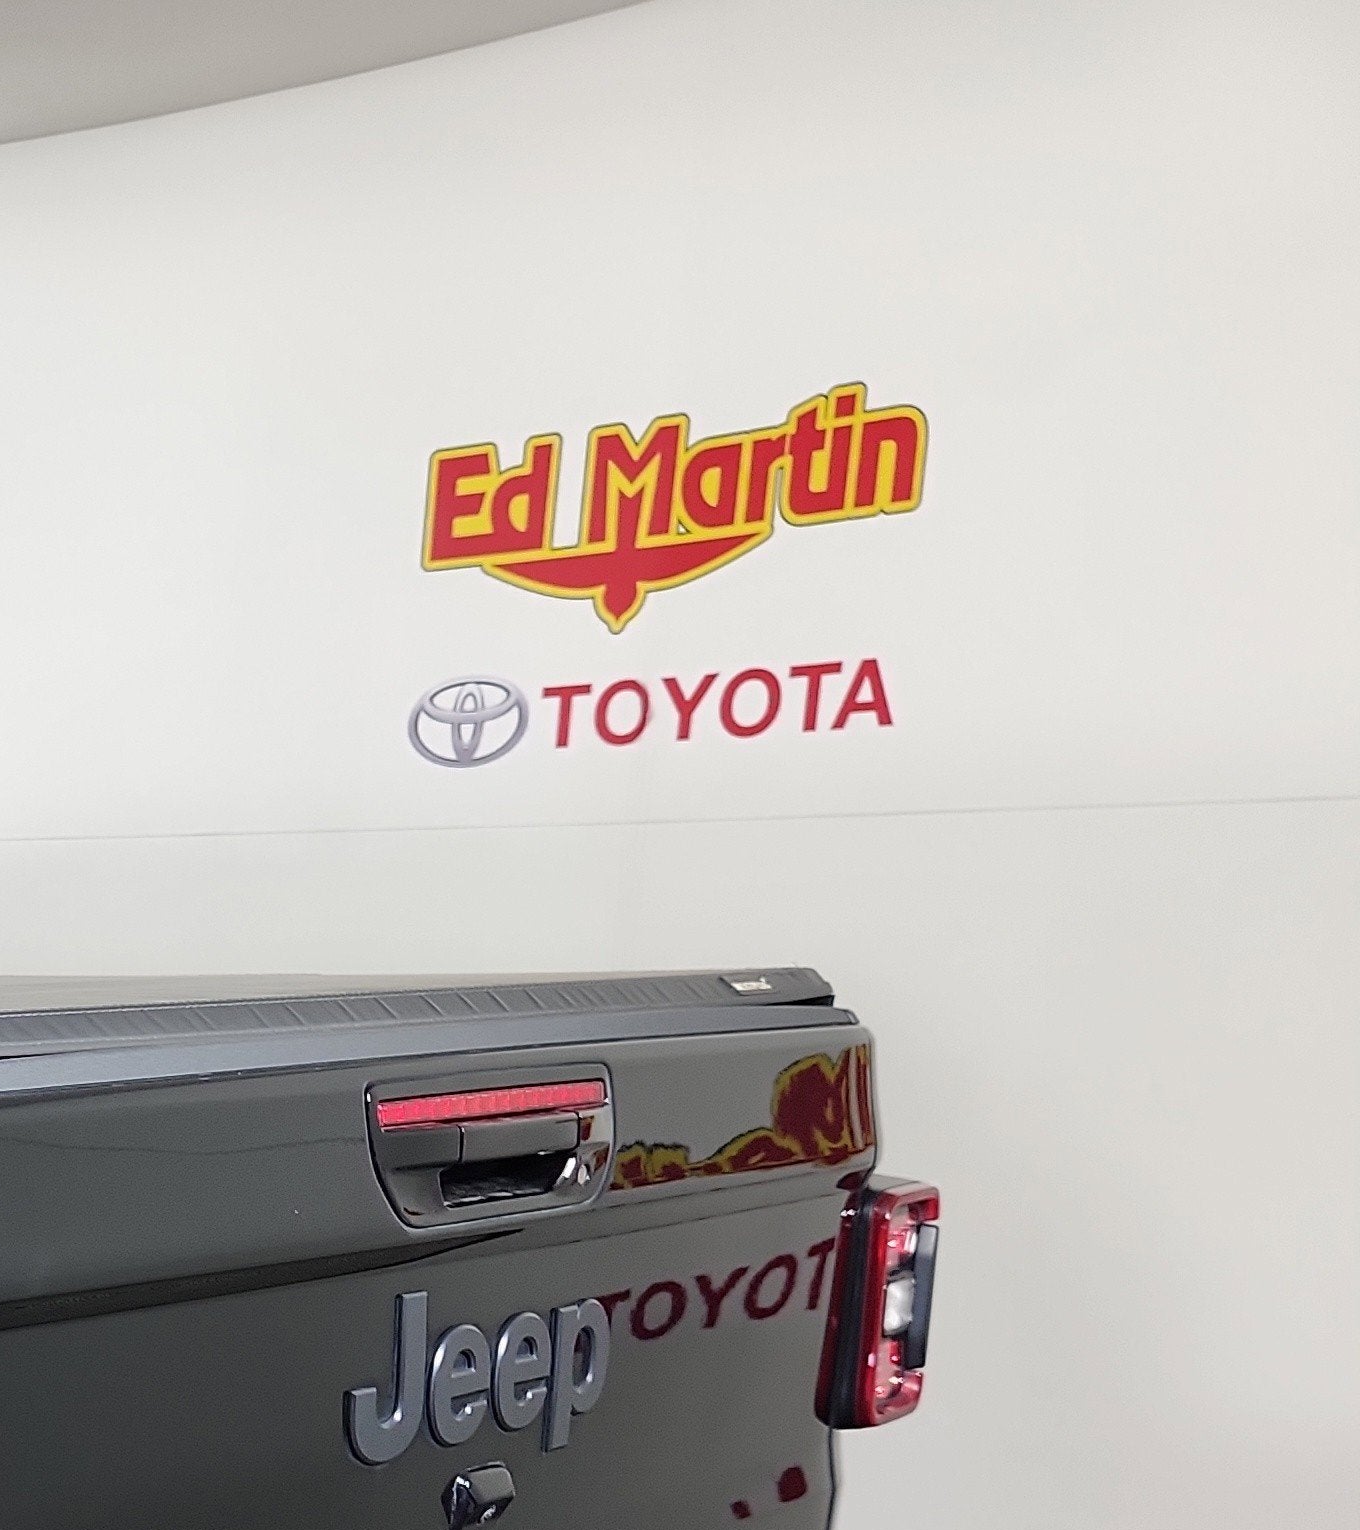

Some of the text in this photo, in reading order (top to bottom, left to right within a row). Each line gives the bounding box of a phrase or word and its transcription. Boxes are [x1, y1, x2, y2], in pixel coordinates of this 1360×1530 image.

[426, 388, 924, 562] Ed Martin
[542, 657, 895, 749] TOYOTA
[343, 1291, 612, 1467] Jeep
